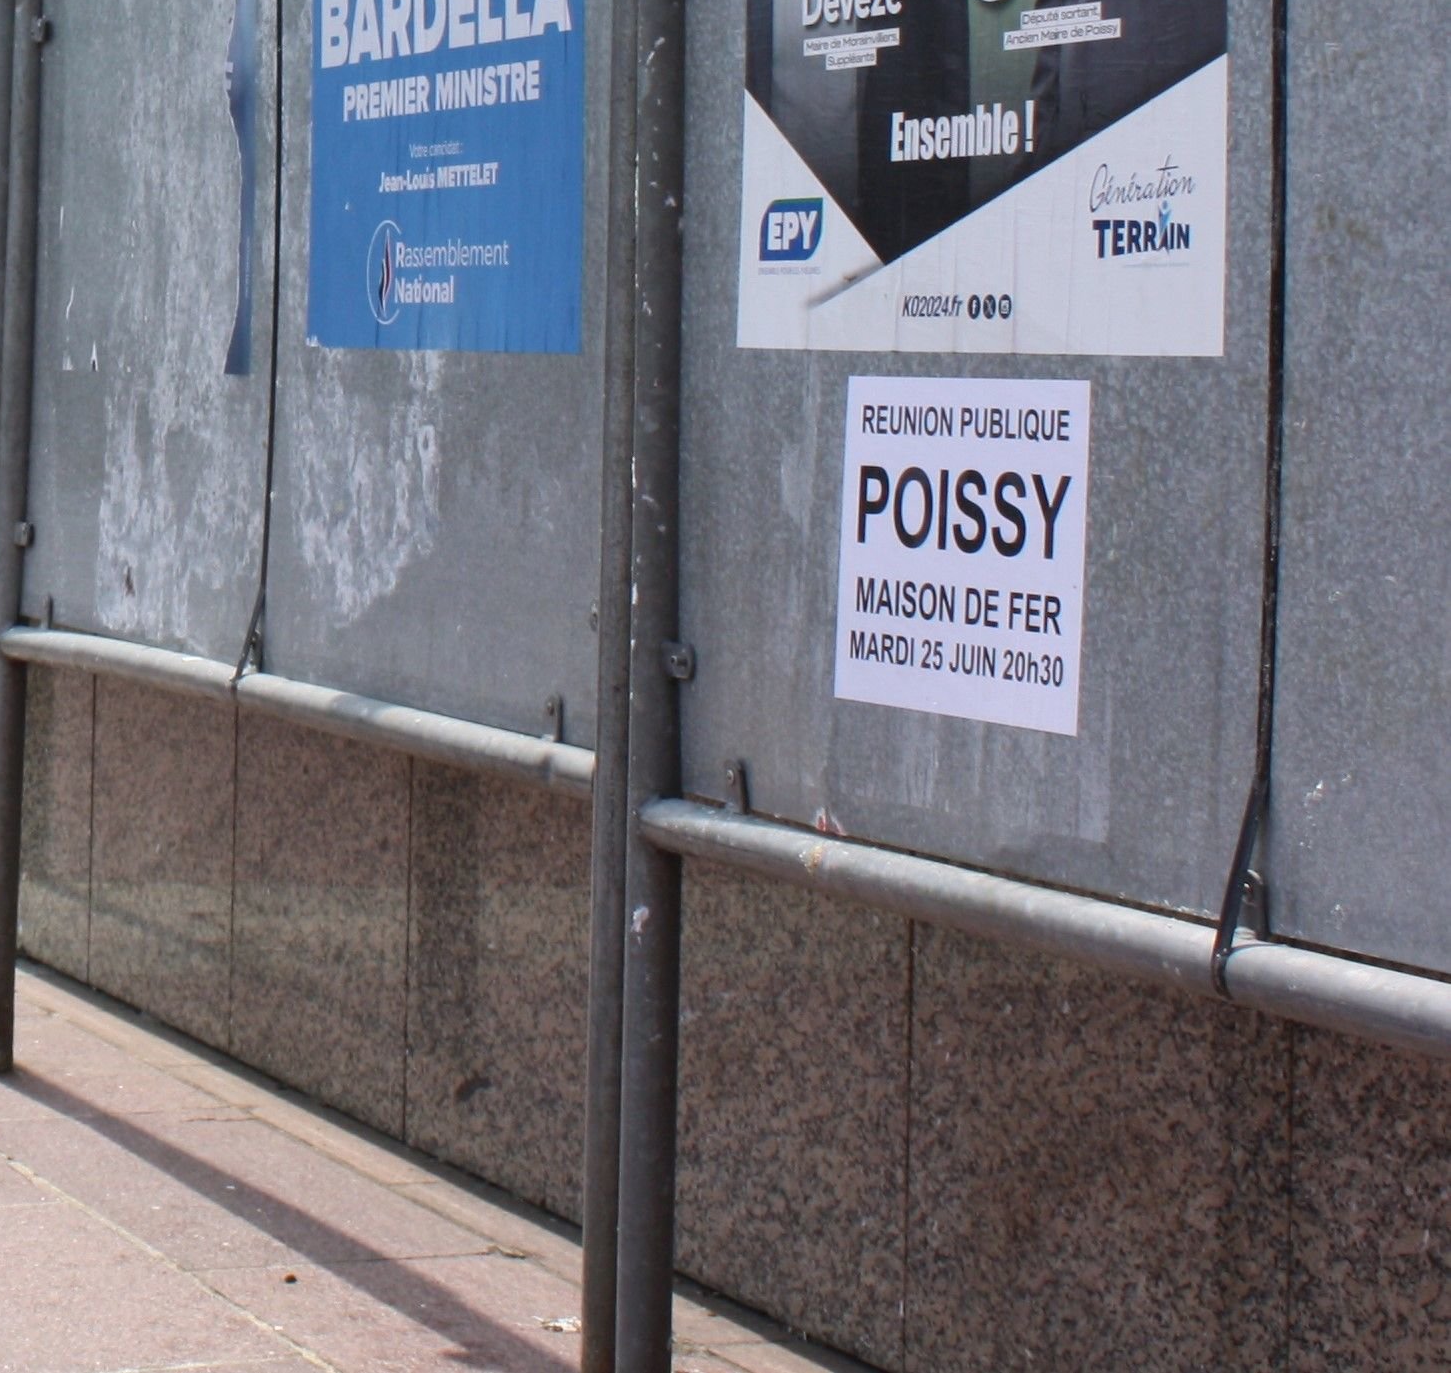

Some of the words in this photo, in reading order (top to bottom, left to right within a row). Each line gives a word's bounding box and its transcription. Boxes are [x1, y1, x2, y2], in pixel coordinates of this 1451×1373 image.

[1022, 7, 1060, 26] Député
[830, 37, 842, 50] de
[1005, 30, 1039, 47] Ancien
[1041, 25, 1069, 42] Maire
[1071, 26, 1084, 39] de
[343, 75, 430, 122] PREMIER
[435, 60, 541, 112] MINISTRE
[890, 100, 1018, 162] Ensemble
[1024, 100, 1035, 153] !
[379, 166, 435, 193] Jean-Louis
[437, 162, 498, 188] METTELET
[1089, 155, 1196, 214] Génération
[767, 210, 818, 251] EPY
[395, 238, 510, 268] Rassemblement
[394, 275, 455, 305] National
[862, 405, 953, 437] REUNION
[960, 407, 1070, 441] PUBLIQUE
[856, 465, 1072, 560] POISSY
[855, 576, 955, 623] MAISON
[964, 588, 999, 629] DE
[1008, 592, 1062, 636] FER
[849, 630, 915, 667] MARDI
[920, 639, 943, 670] 25
[949, 643, 996, 678] JUIN
[1002, 649, 1063, 687] 20h30
